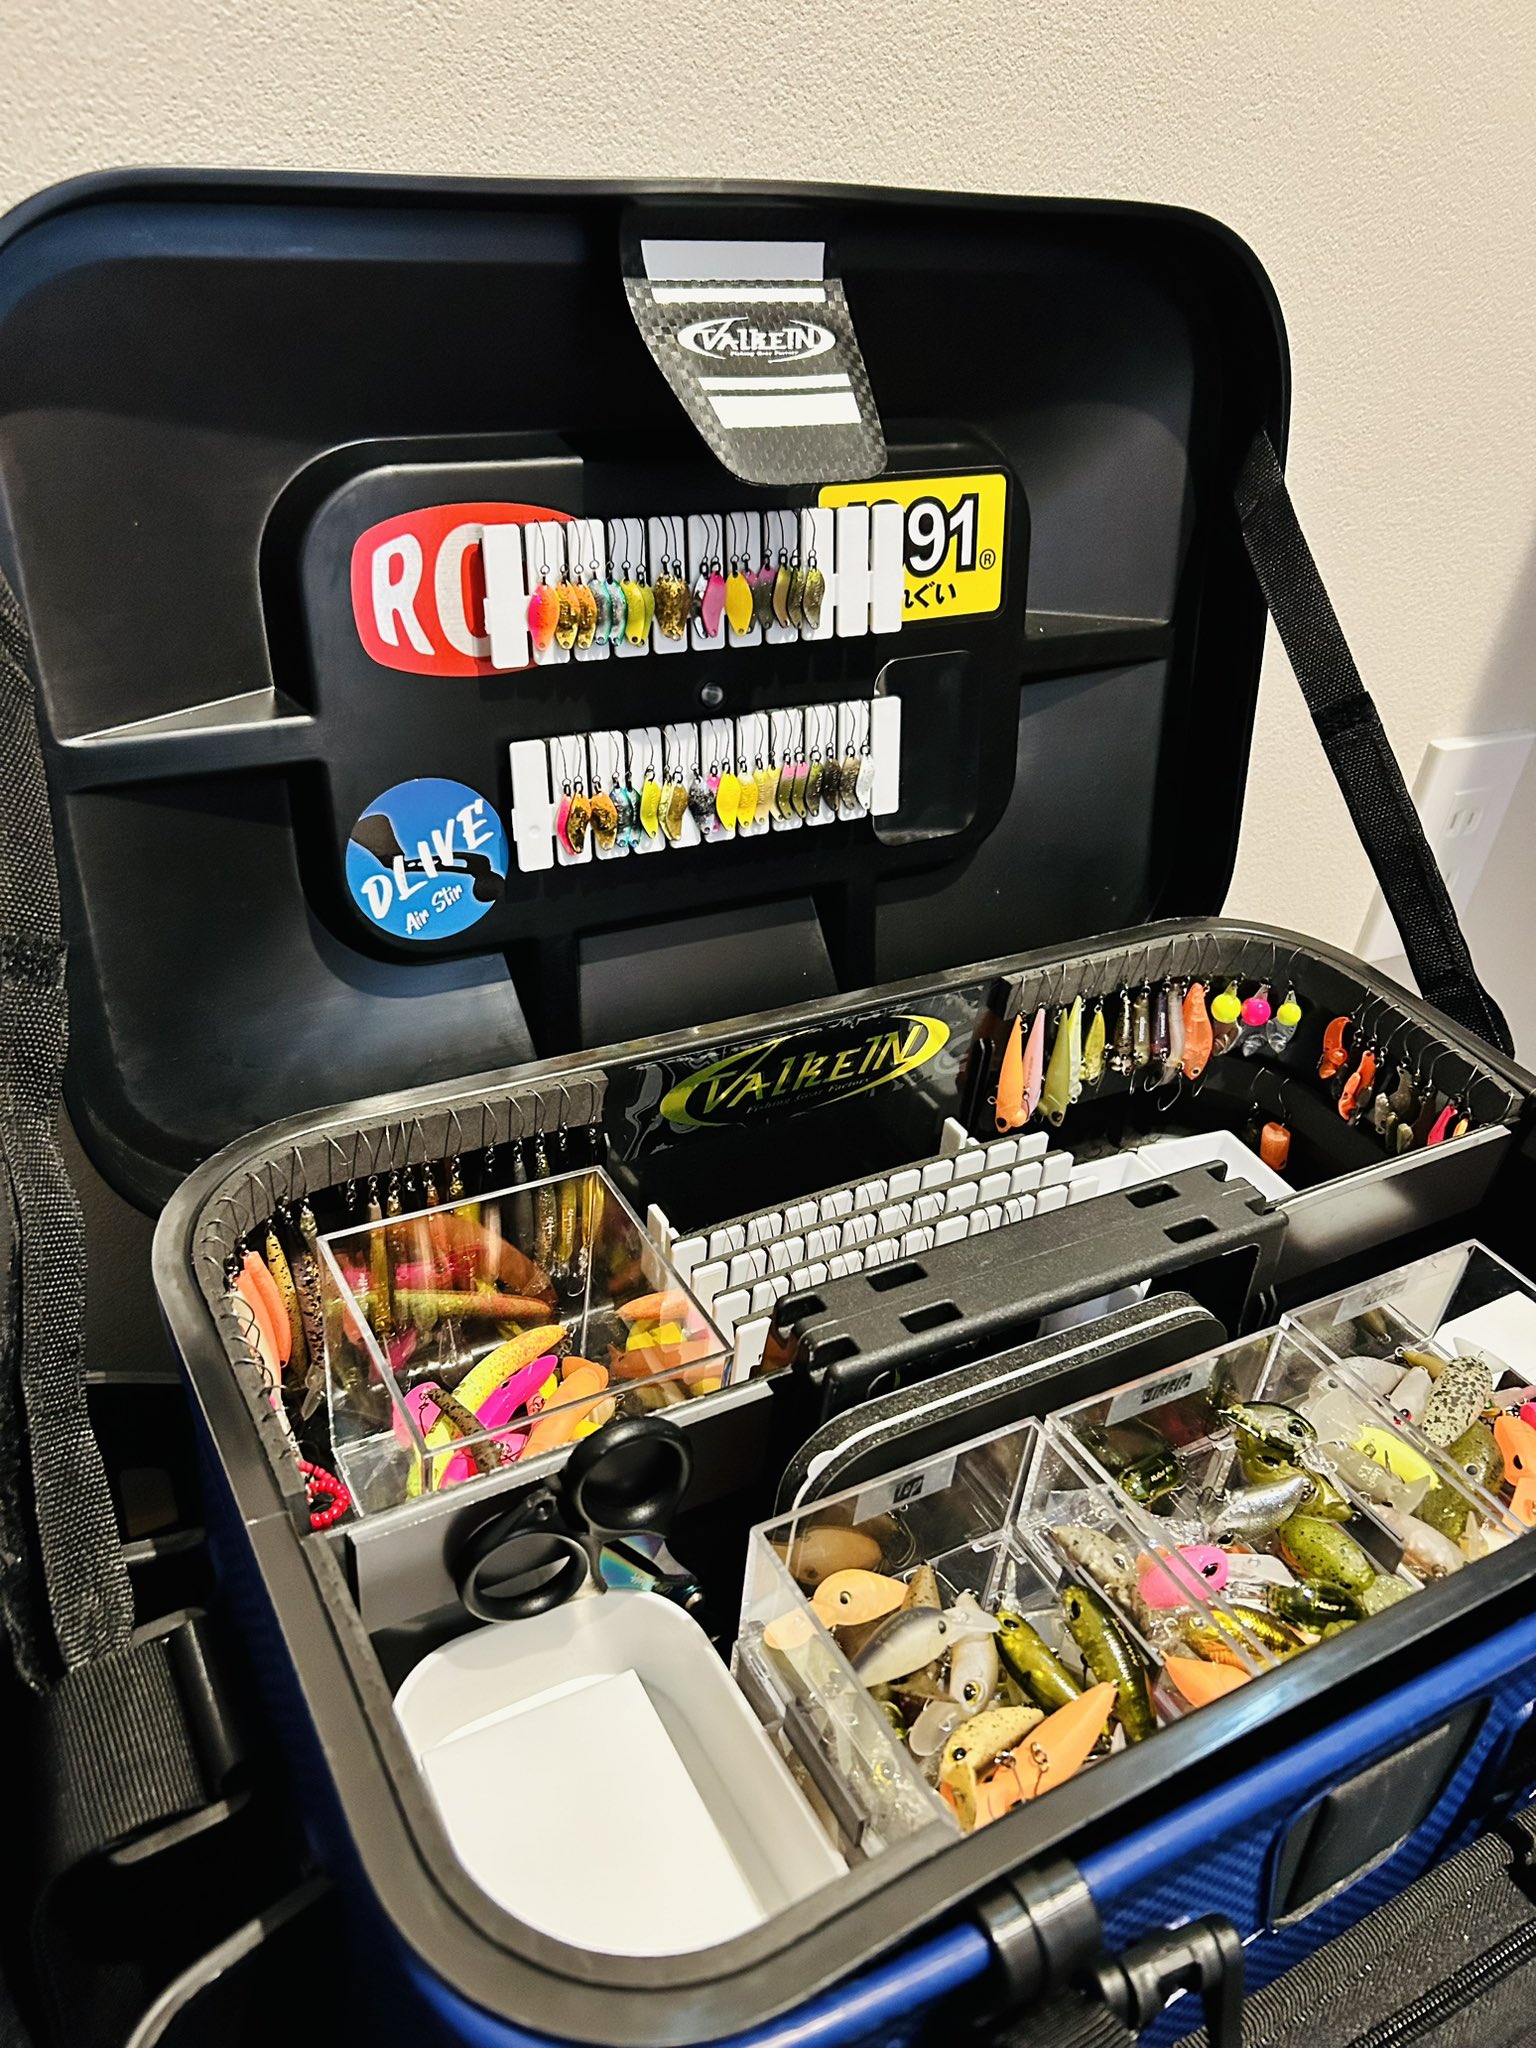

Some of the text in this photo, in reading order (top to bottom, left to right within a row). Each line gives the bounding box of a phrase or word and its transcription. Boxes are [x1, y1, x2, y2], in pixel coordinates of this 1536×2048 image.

[360, 798, 494, 919] DLIVE
[405, 884, 464, 935] Air Stir
